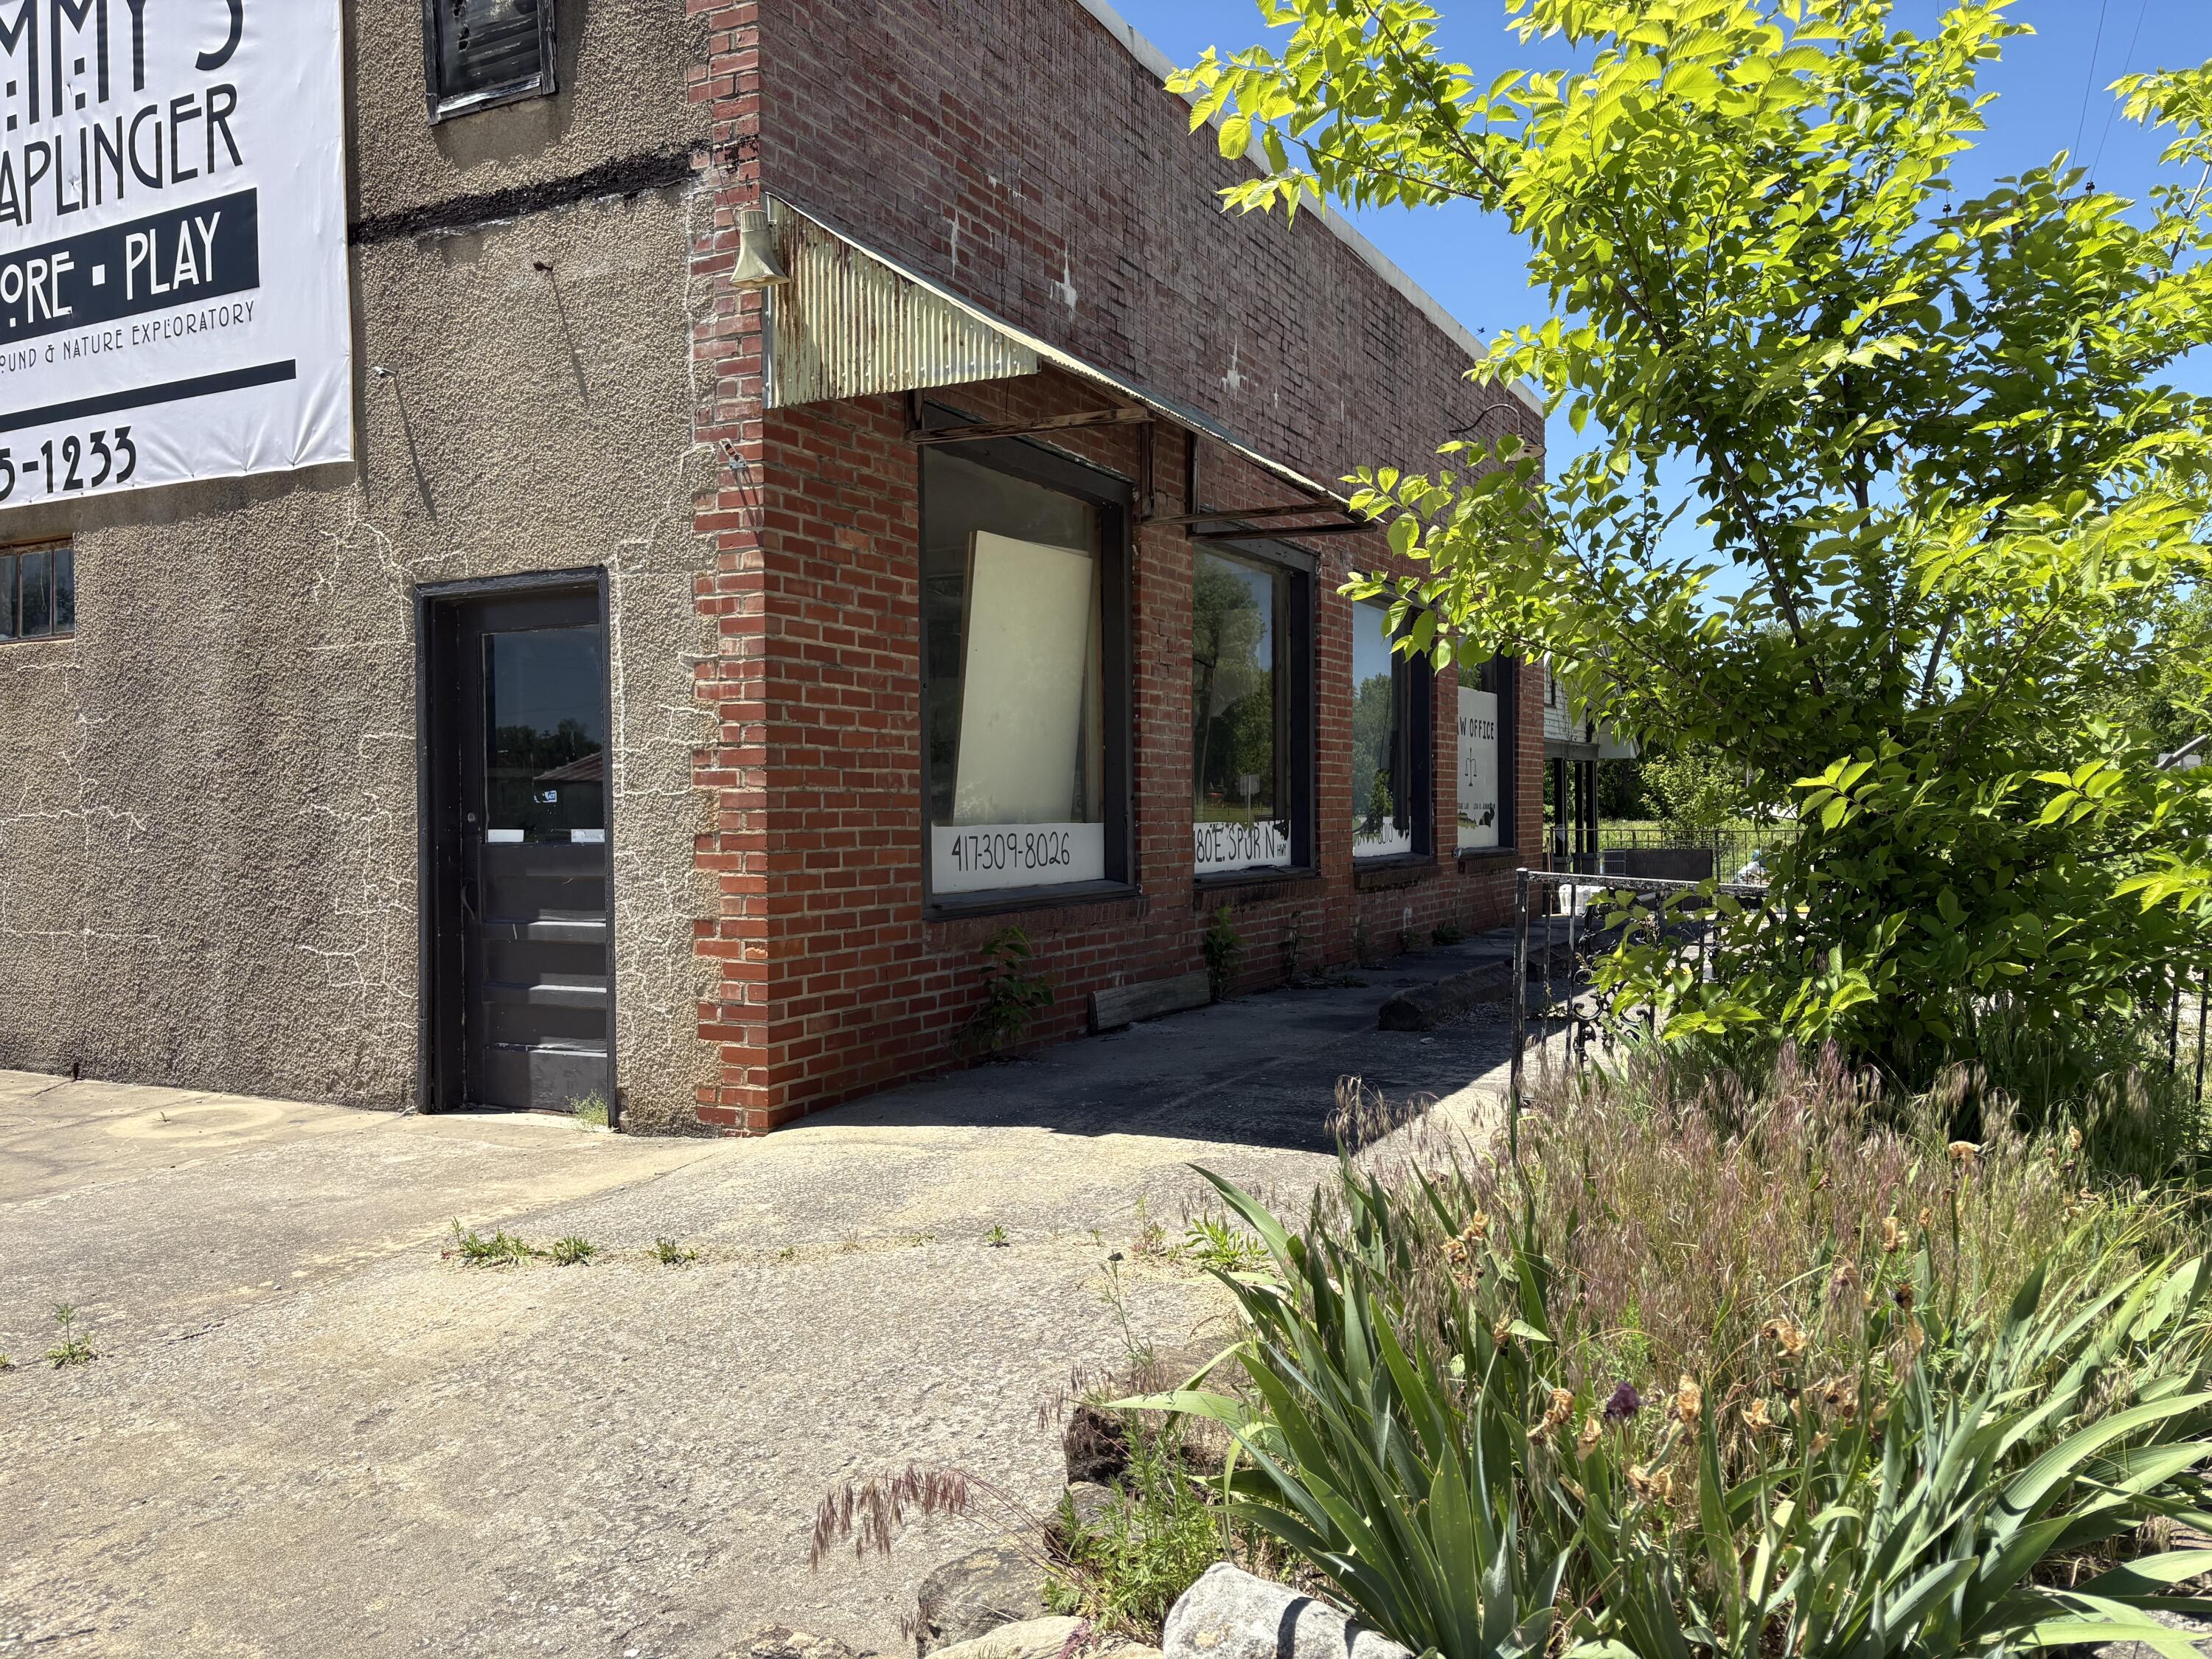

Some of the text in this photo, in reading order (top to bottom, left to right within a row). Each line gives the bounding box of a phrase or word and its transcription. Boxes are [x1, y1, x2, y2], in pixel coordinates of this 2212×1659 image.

[0, 83, 243, 226] APLINGER
[126, 212, 220, 300] PLAY
[45, 344, 55, 363] &
[63, 329, 122, 360] NATURE
[133, 301, 254, 344] EXPLORATORY
[1470, 718, 1494, 740] OFFICE
[951, 831, 1070, 872] 417-309-8026
[1228, 827, 1261, 860] SPUR
[1265, 825, 1274, 859] N
